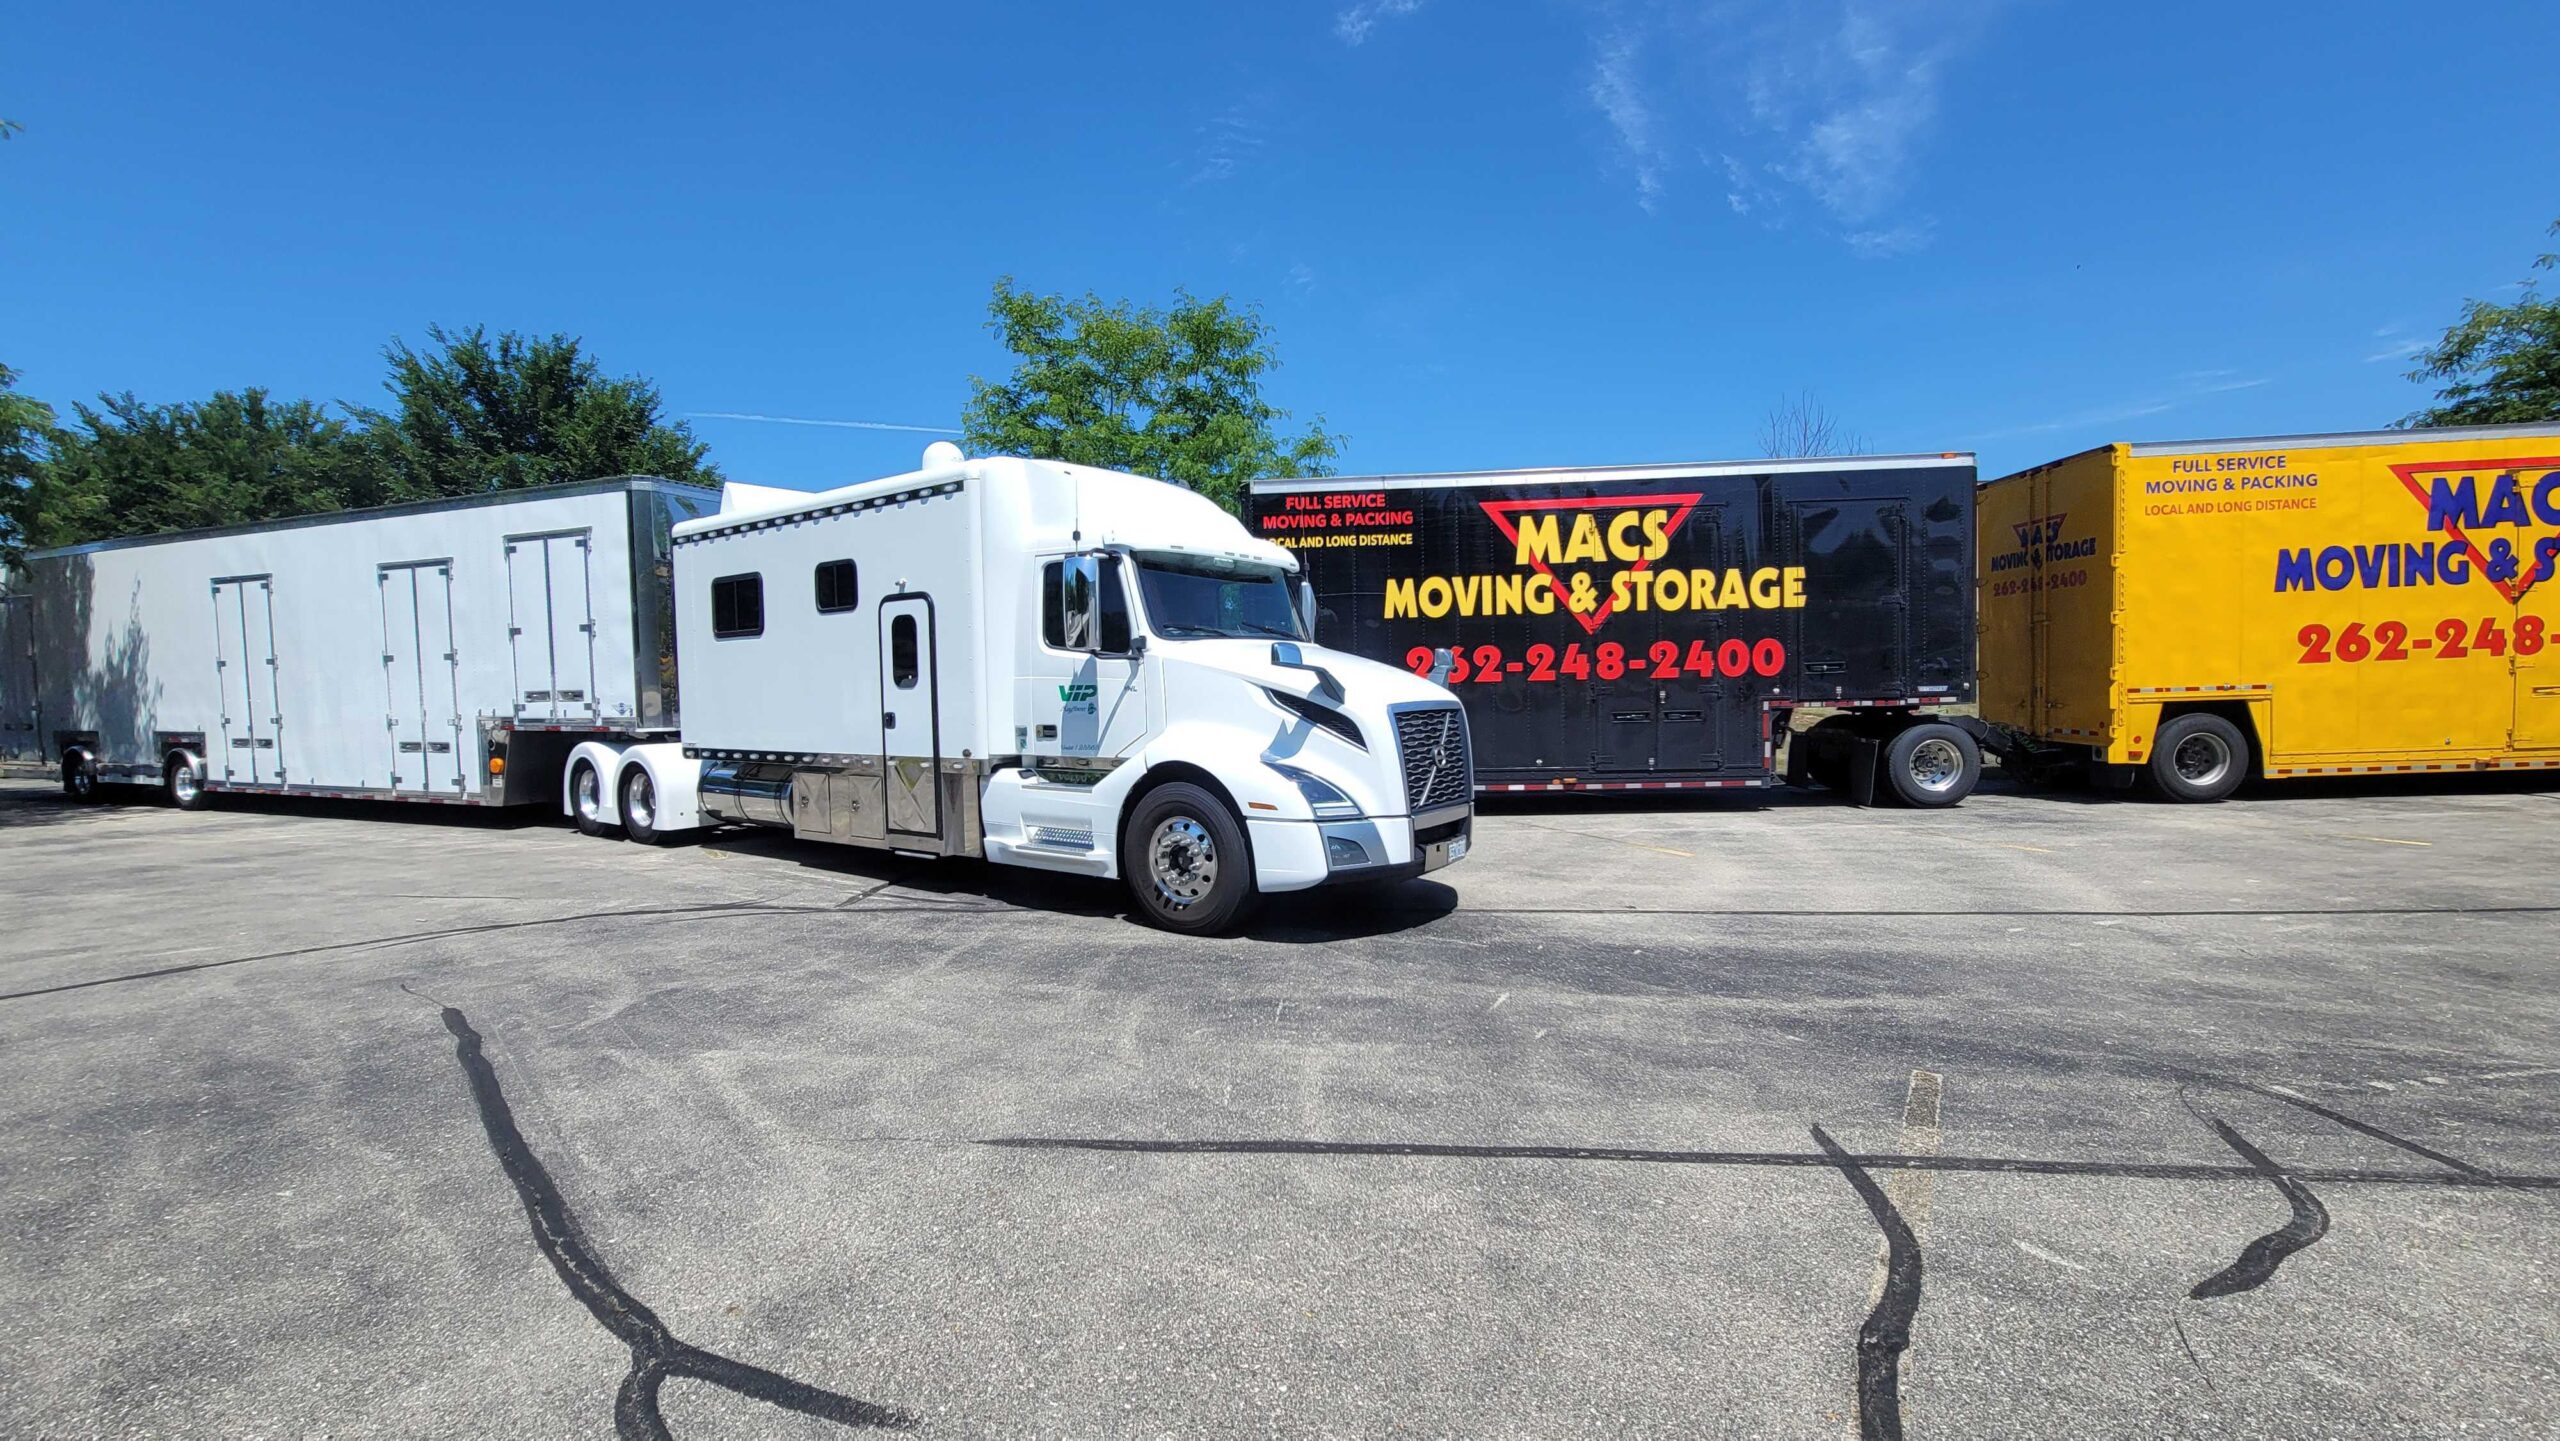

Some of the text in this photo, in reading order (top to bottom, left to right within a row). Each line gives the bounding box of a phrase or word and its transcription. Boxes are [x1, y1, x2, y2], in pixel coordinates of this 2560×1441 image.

[2173, 455, 2287, 473] FULL SERVICE
[2146, 473, 2318, 494] MOVING & PACKING
[1286, 494, 1386, 510] FULL SERVICE
[2145, 498, 2317, 516] LOCAL AND LONG DISTANCE
[1263, 511, 1414, 529] MOVING & PACKING
[1270, 533, 1413, 548] CAL AND LONG DISTANCE
[1515, 509, 1669, 565] MACS
[2274, 539, 2470, 592] MOVING
[2486, 537, 2519, 582] &
[1384, 566, 1807, 619] MOVING & STORAGE
[1406, 638, 1785, 684] 262-248-2400
[1059, 685, 1097, 701] VIP
